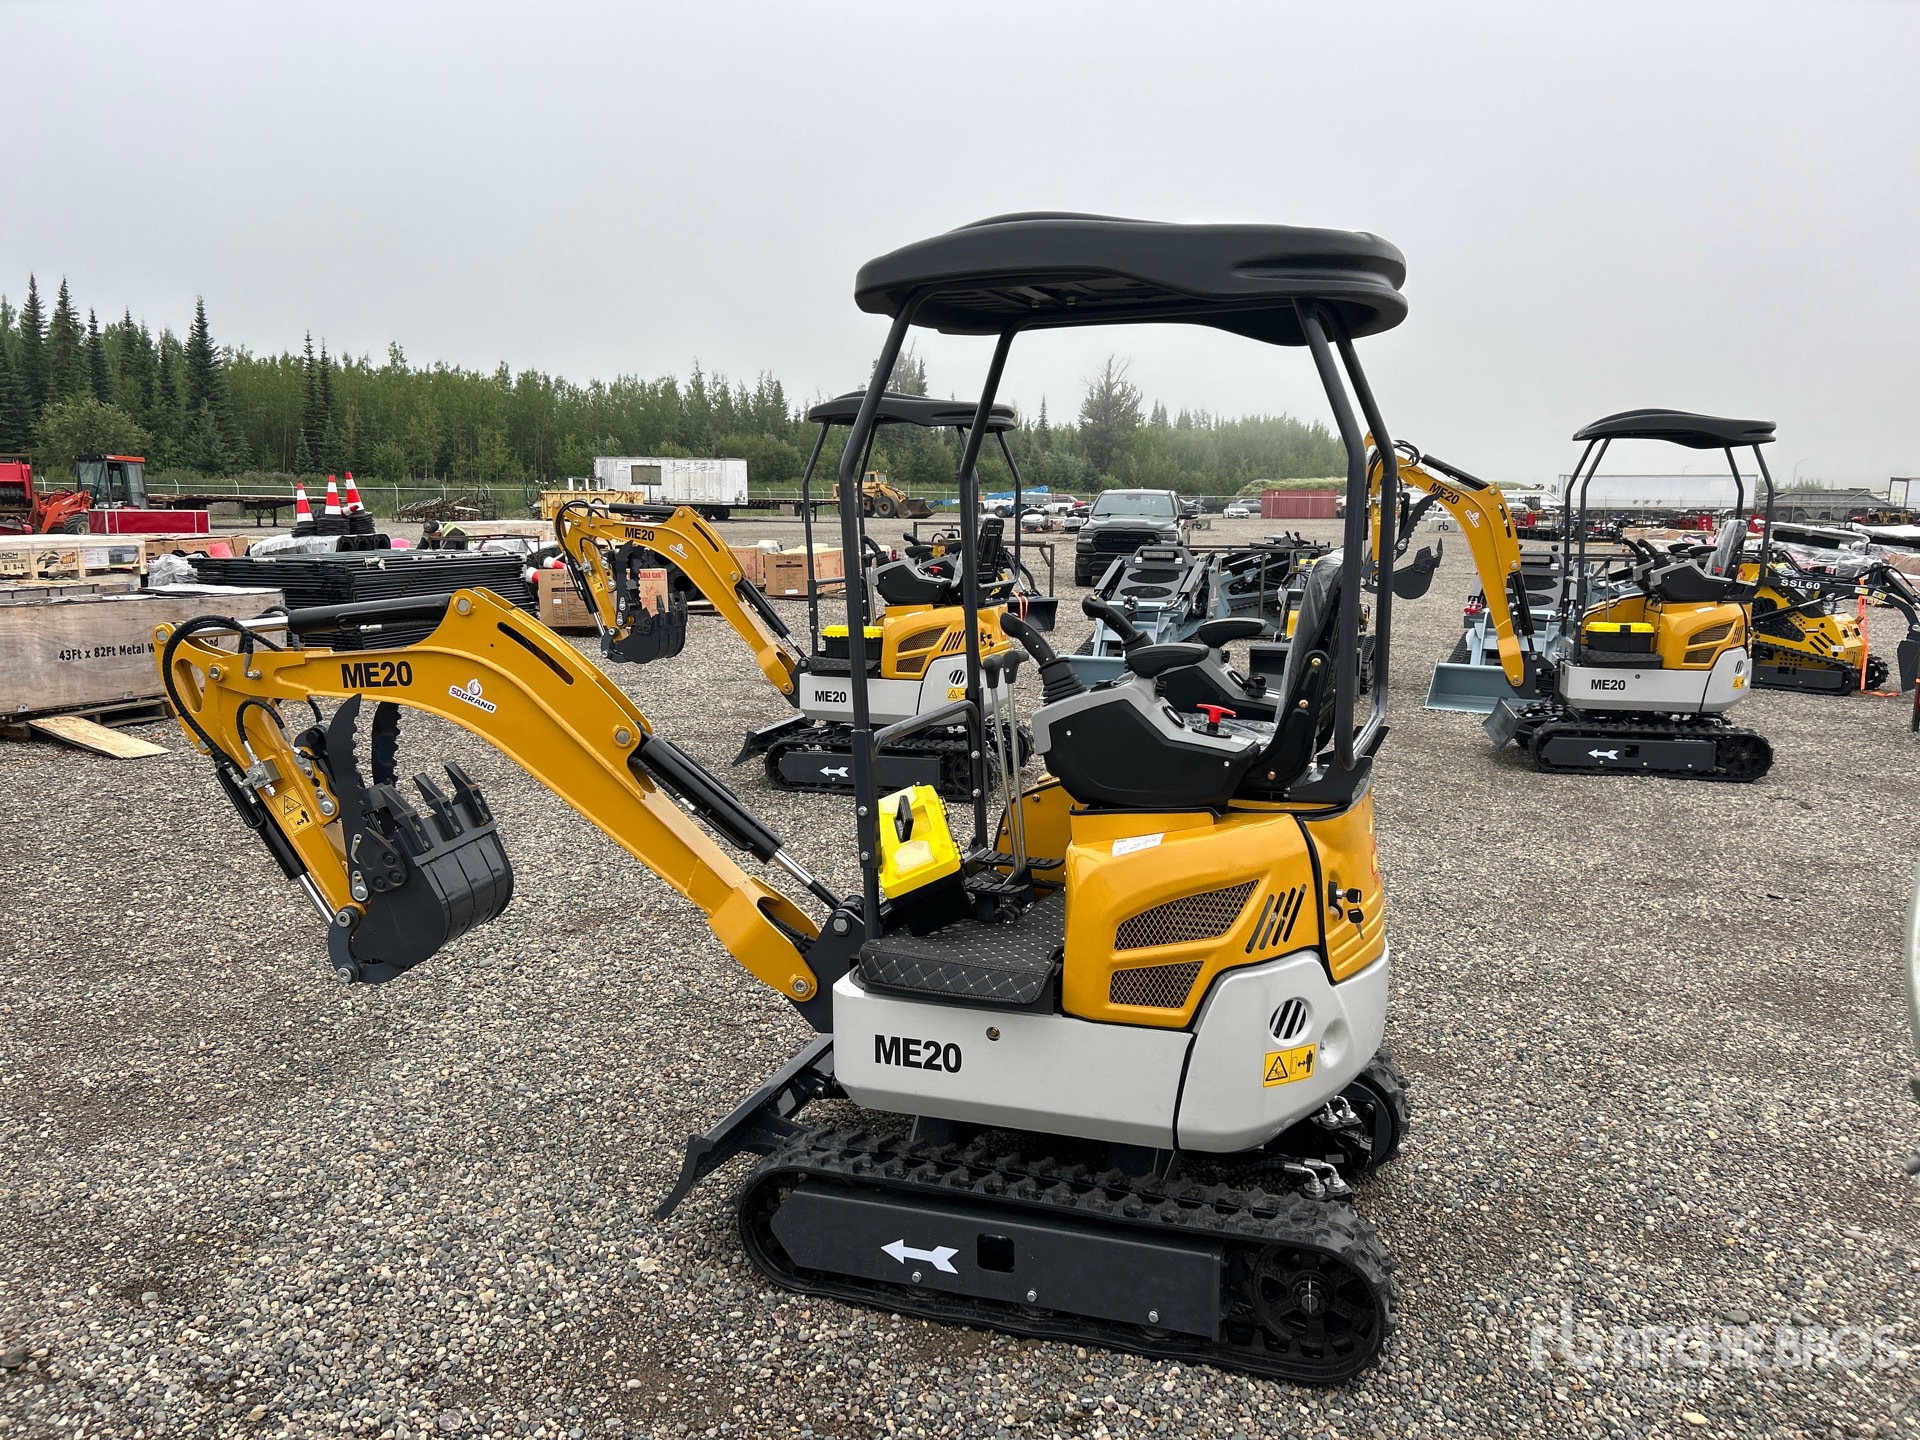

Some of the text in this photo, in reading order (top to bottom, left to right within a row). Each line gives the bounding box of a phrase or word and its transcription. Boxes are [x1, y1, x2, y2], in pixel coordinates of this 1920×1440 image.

[1429, 482, 1460, 505] ME20
[1438, 521, 1449, 531] rb
[624, 527, 655, 542] ME20
[1780, 579, 1820, 590] SSL60
[59, 649, 82, 660] 43Ft
[85, 650, 91, 658] x
[94, 646, 116, 658] 82Ft
[119, 643, 145, 655] Metal
[340, 660, 413, 689] ME20
[1590, 679, 1626, 691] ME20
[814, 690, 847, 703] ME20
[874, 1034, 963, 1074] ME20
